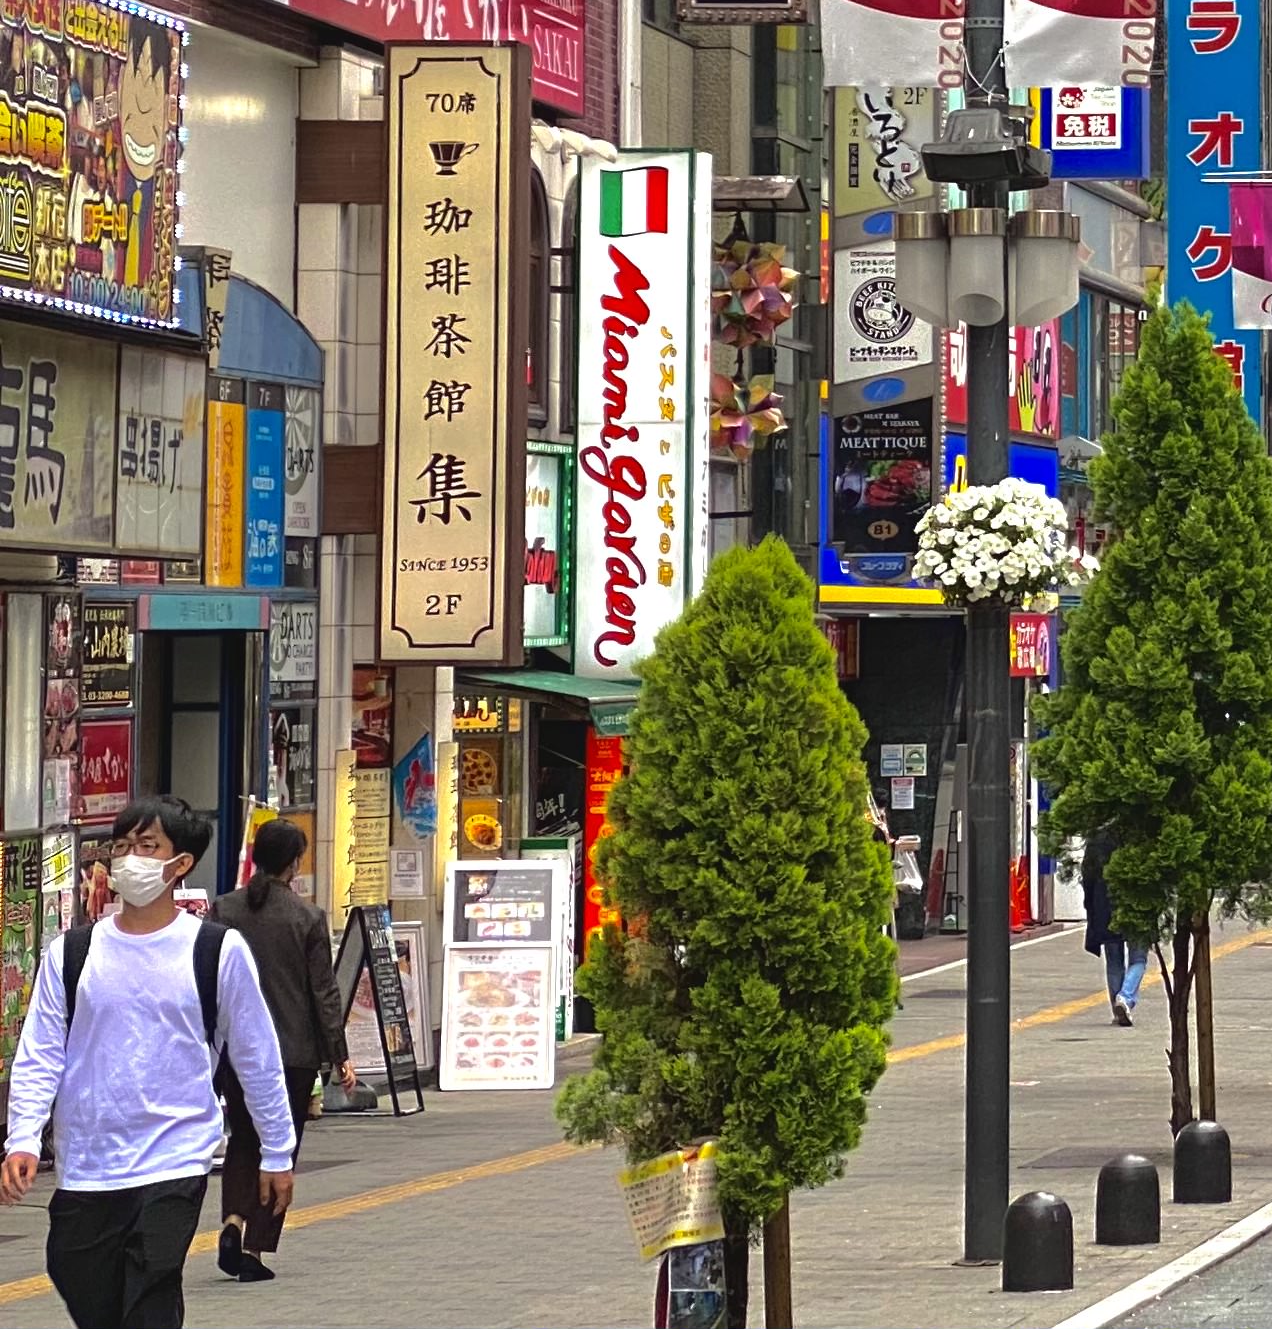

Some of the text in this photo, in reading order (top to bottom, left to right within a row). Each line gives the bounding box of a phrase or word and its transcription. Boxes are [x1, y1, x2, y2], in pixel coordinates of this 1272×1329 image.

[532, 23, 579, 83] SAKAI
[424, 92, 476, 116] 70席
[904, 86, 928, 105] 2F
[1062, 115, 1110, 137] 免税
[855, 285, 874, 309] BEEF
[867, 326, 901, 340] STAND
[600, 245, 651, 450] Miami
[408, 197, 482, 526] 珈琲茶館 集
[218, 380, 232, 402] 6F
[259, 387, 271, 407] 7F
[119, 406, 185, 494] 串揚げ
[840, 436, 927, 450] MEAT TIQUE
[287, 446, 315, 473] DARTS
[657, 325, 676, 587] パスタとピザの店
[873, 523, 892, 536] B1
[399, 555, 490, 573] SINCE 1953
[425, 593, 462, 616] 2F
[280, 612, 314, 640] DARTS
